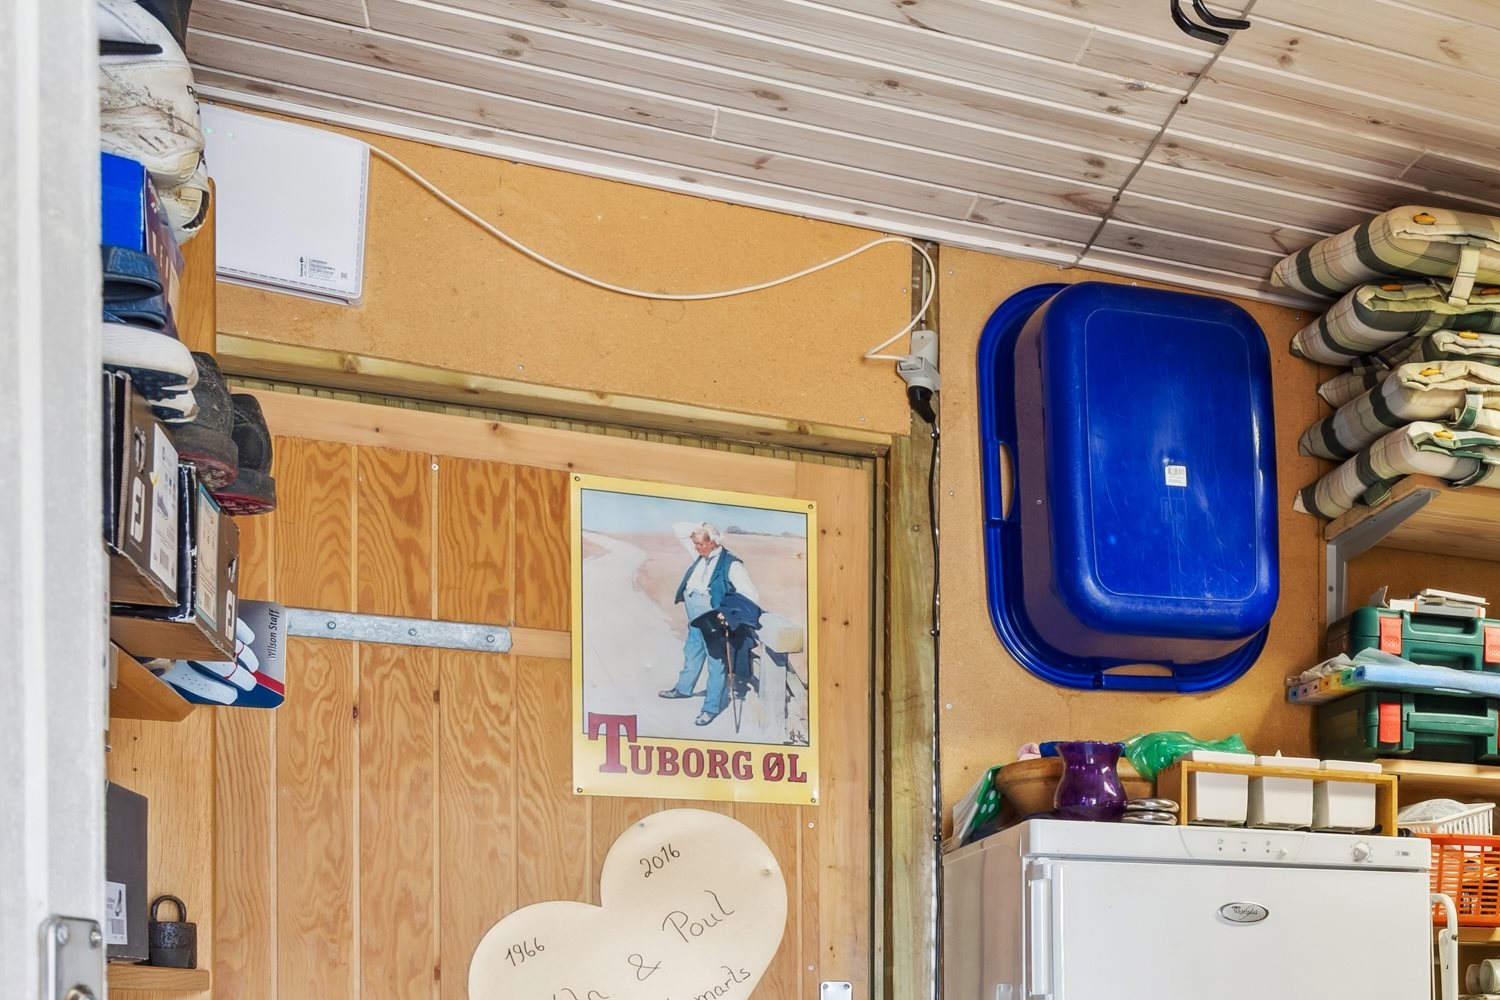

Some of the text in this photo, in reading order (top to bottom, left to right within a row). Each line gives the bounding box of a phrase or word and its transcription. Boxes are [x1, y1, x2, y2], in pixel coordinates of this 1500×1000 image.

[267, 608, 281, 661] Wilson Staff
[588, 711, 808, 784] TUBORG ØL
[639, 843, 681, 878] 2016
[504, 937, 546, 968] 1966
[627, 953, 663, 981] &
[662, 890, 736, 944] Poul
